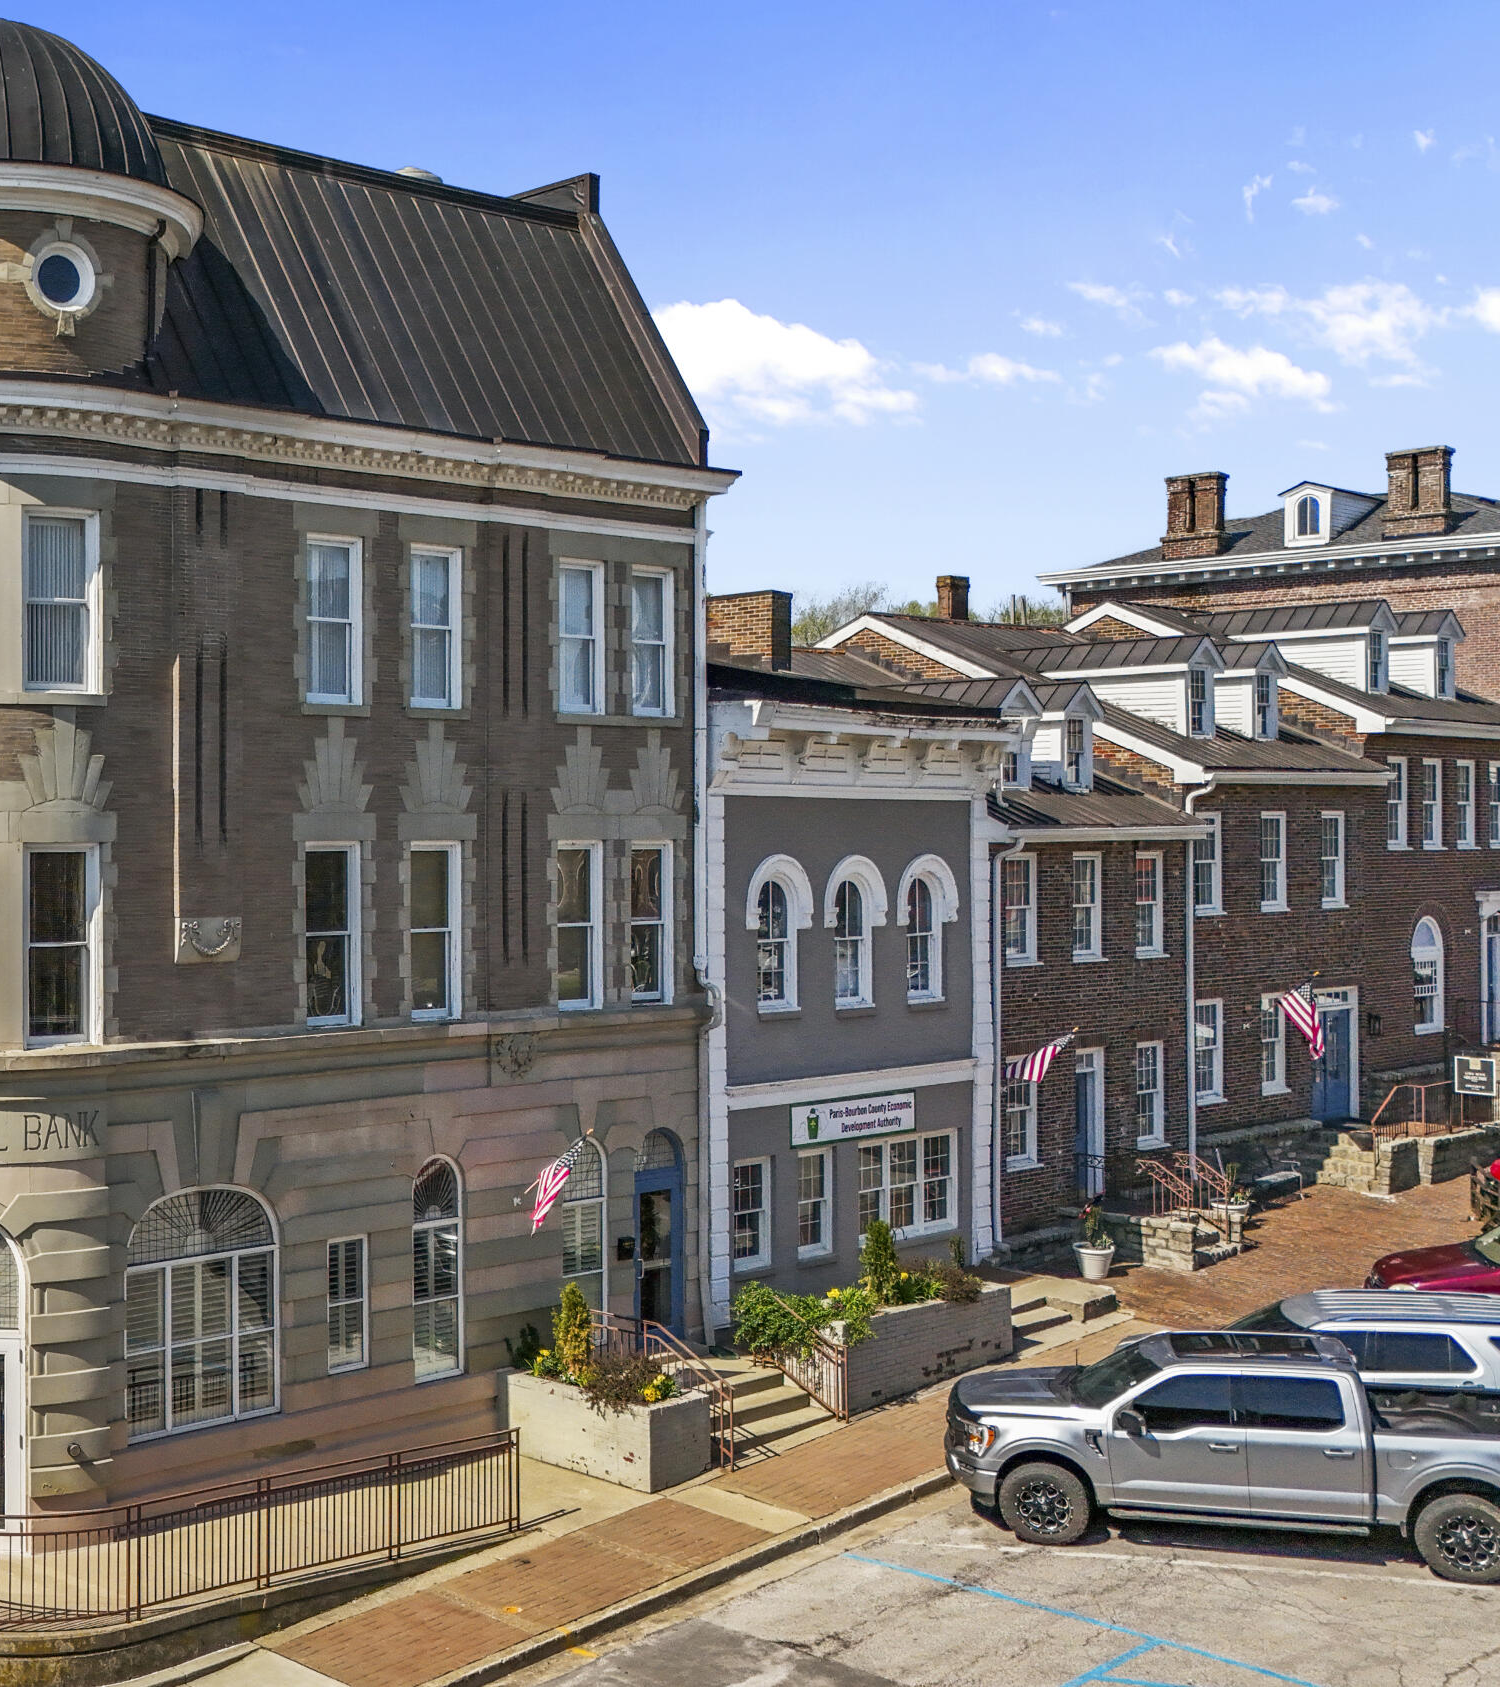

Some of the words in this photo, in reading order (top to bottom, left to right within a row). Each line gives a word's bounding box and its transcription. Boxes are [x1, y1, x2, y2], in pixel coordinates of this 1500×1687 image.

[829, 1105, 867, 1119] Paris-Bourbon
[868, 1103, 886, 1114] County
[887, 1099, 912, 1111] Economic
[23, 1110, 100, 1150] BANK
[841, 1119, 876, 1133] Development
[877, 1116, 901, 1128] Authority
